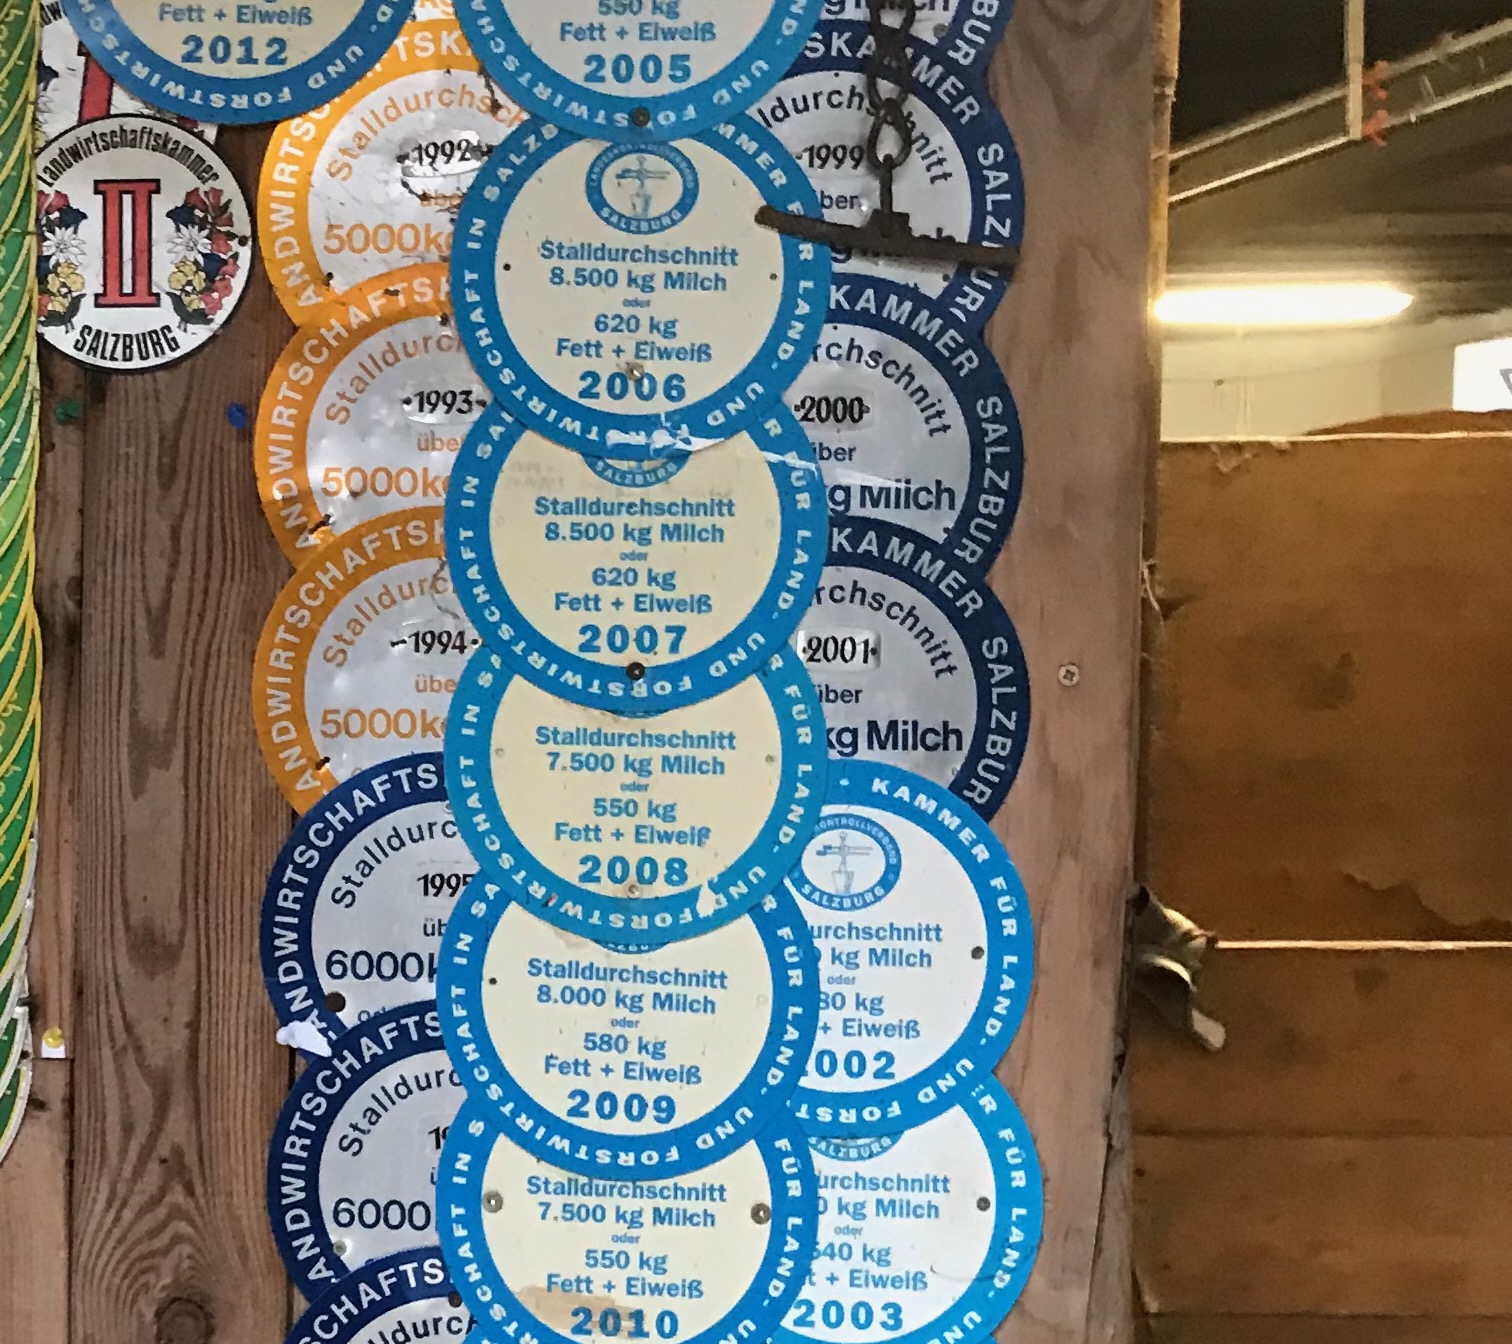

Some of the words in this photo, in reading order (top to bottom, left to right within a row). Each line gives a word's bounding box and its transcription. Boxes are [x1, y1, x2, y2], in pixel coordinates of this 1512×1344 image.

[560, 22, 606, 41] Fett
[639, 22, 716, 41] Eiweiß
[182, 35, 287, 65] 2012
[584, 54, 690, 83] 2005
[413, 139, 472, 165] 1992
[804, 145, 864, 169] 1999
[74, 323, 180, 363] SALZBURG
[579, 371, 685, 402] 2006
[412, 392, 473, 415] 1993
[800, 398, 862, 423] 2000
[411, 630, 468, 654] 1994
[579, 624, 686, 655] 2007
[808, 638, 871, 663] 2001
[579, 856, 687, 886] 2008
[567, 1090, 675, 1124] 2009
[572, 1307, 677, 1338] 2010
[794, 1300, 902, 1331] 2003
